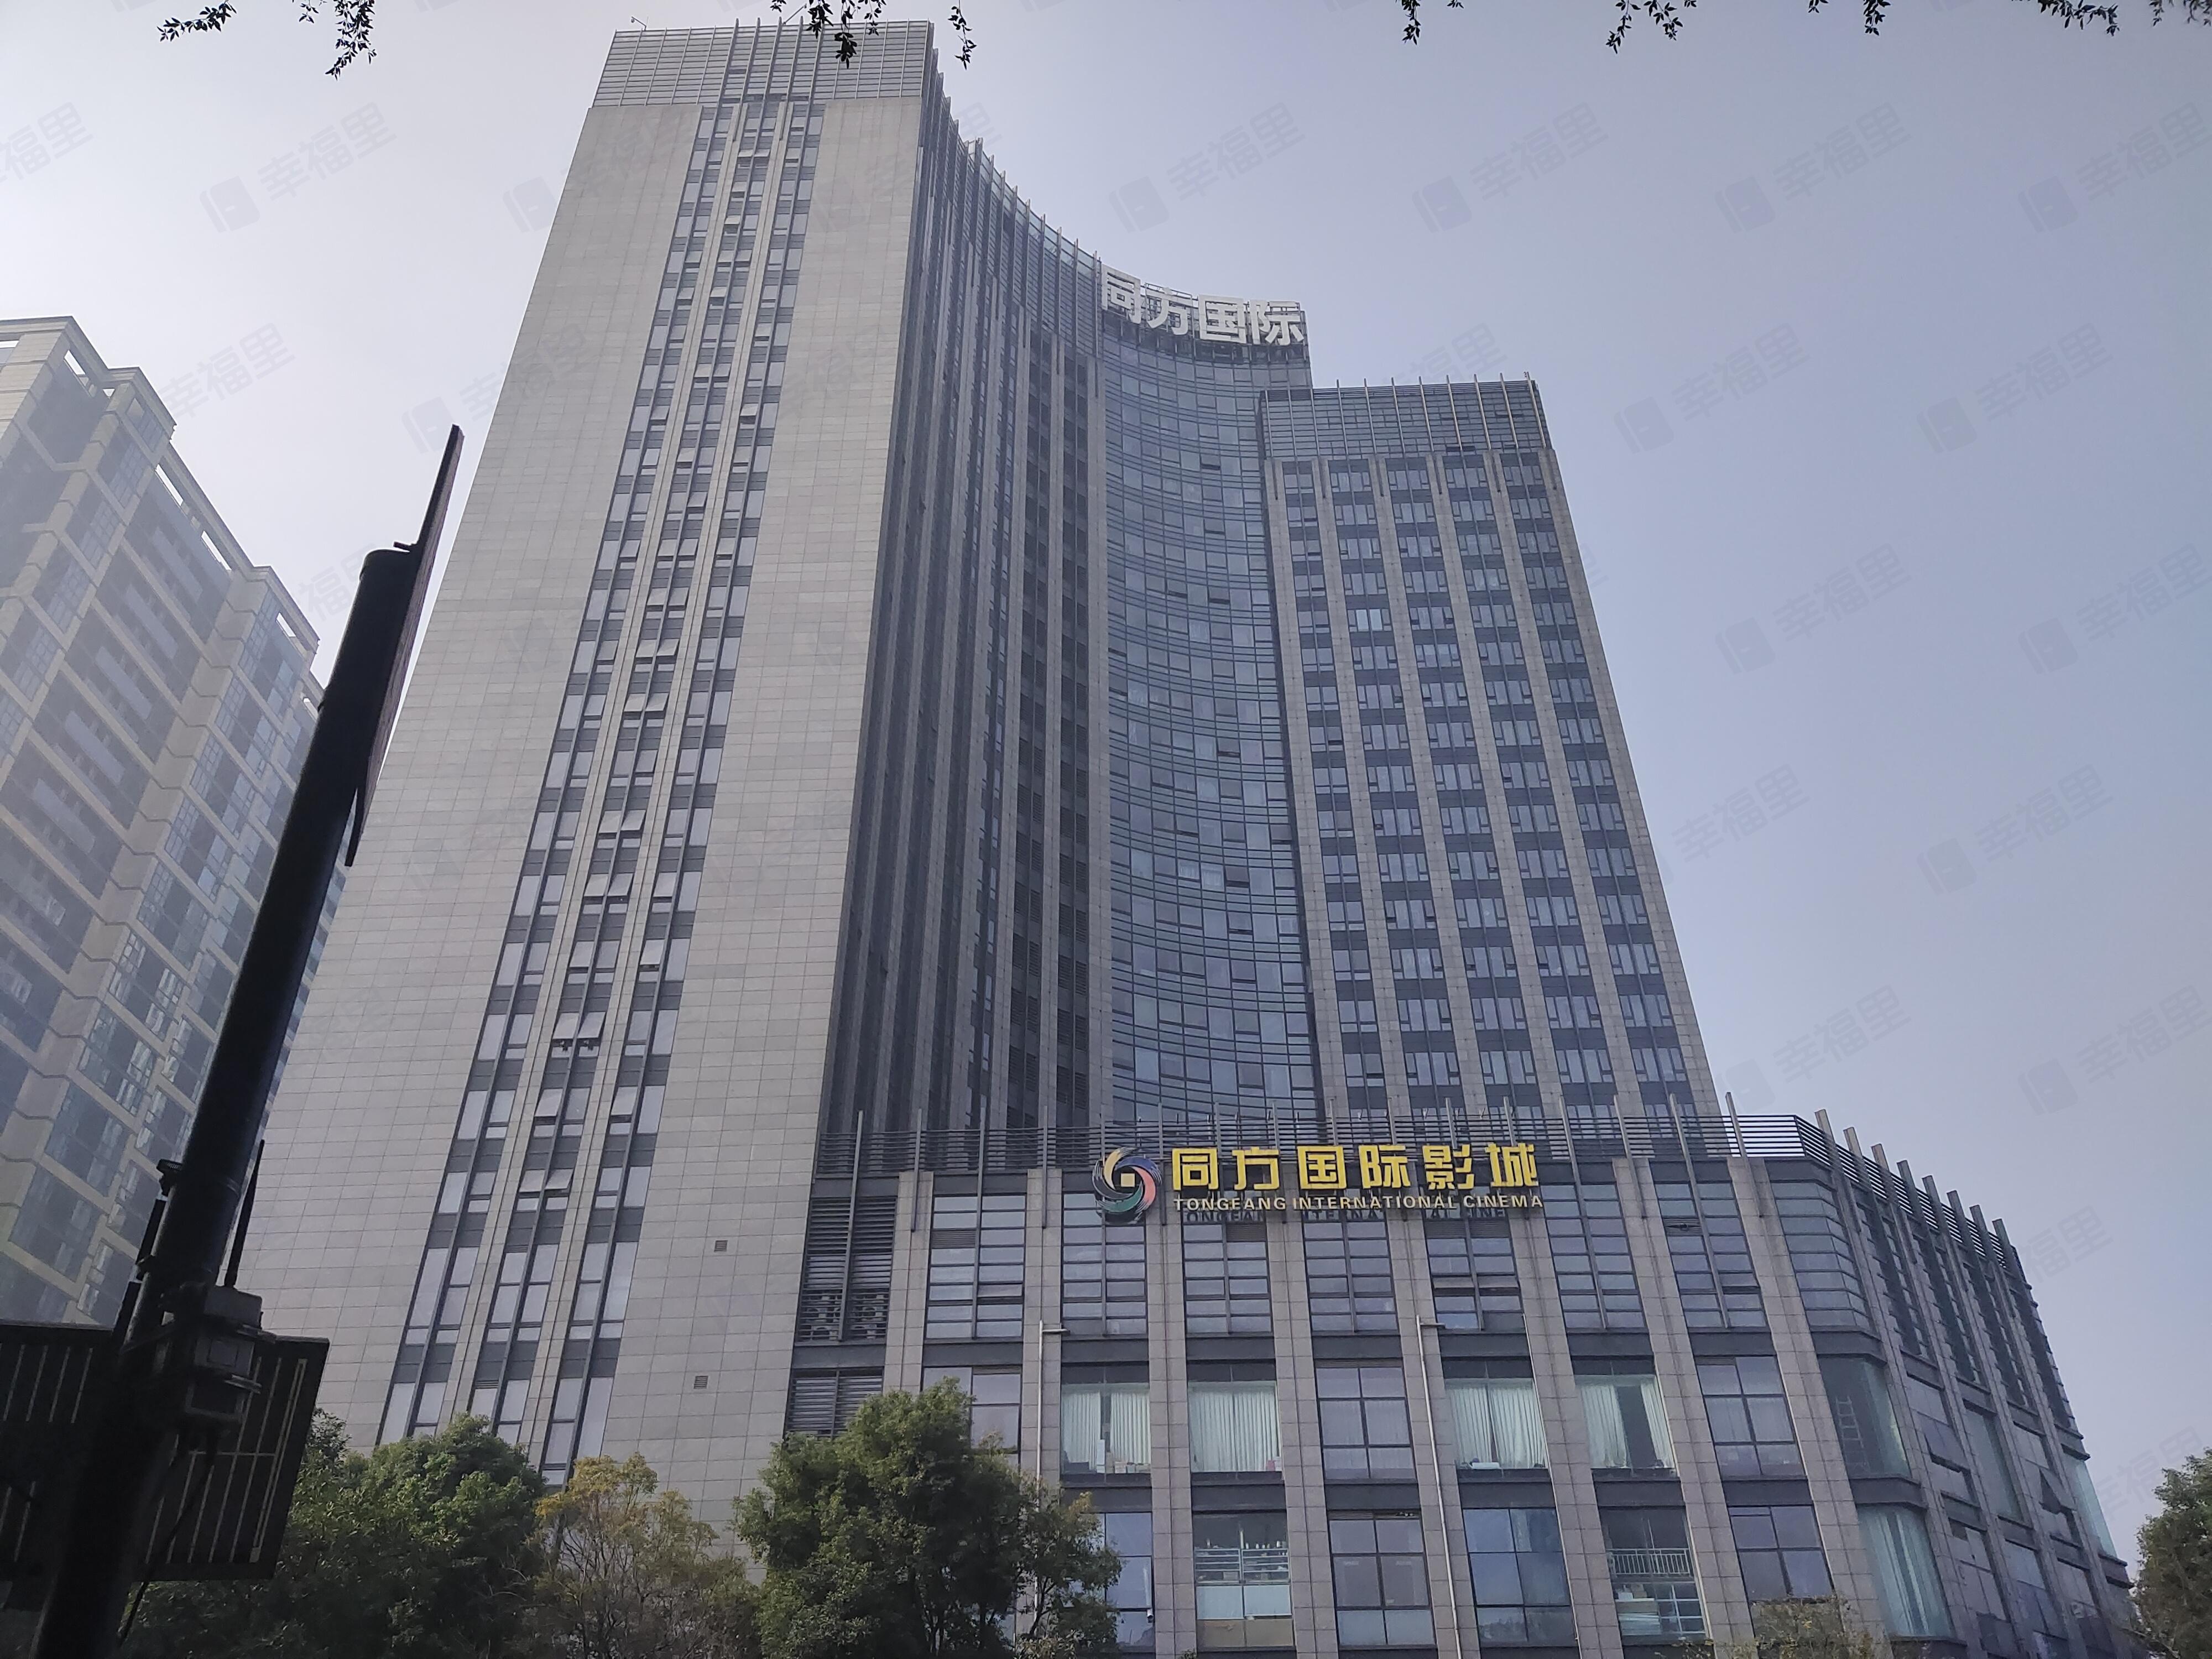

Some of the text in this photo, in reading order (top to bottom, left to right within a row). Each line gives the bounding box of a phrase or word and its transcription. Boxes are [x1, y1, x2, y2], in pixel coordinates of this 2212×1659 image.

[1101, 264, 1304, 346] 同方国际
[1171, 1143, 1539, 1191] 同方国际影城
[1173, 1194, 1543, 1211] TONGFANG INTERNATIONAL CINEMA
